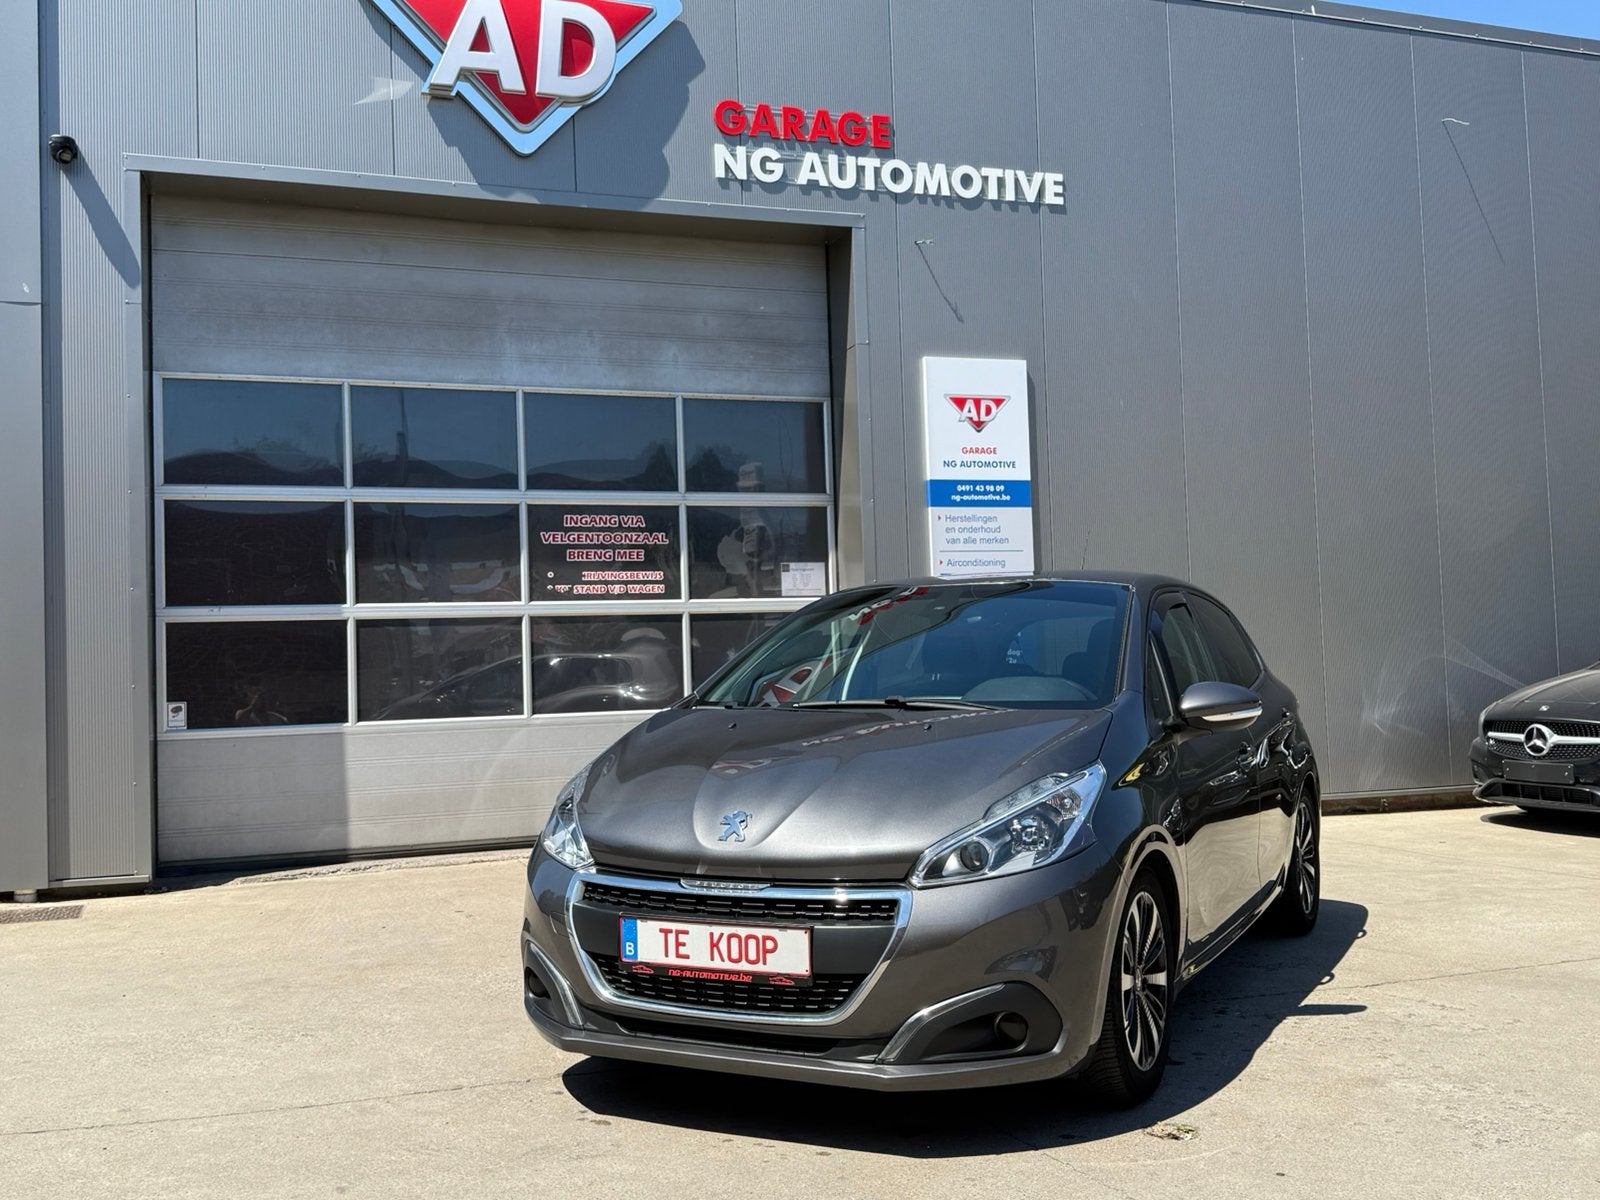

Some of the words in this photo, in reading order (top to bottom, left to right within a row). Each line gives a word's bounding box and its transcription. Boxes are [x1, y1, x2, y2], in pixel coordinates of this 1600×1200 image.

[426, 0, 617, 102] AD
[714, 100, 893, 149] GARAGE
[714, 143, 784, 183] NG
[797, 152, 1065, 205] AUTOMOTIVE
[959, 399, 998, 422] AD
[961, 446, 998, 455] GARAGE
[943, 460, 957, 468] NG
[960, 460, 1017, 469] AUTOMOTIVE
[956, 484, 973, 492] 0491
[975, 484, 984, 492] 43
[995, 484, 1005, 492] 09
[951, 493, 1011, 502] ng-automotive.be
[563, 514, 618, 528] INGANG
[620, 514, 646, 528] VIA
[944, 514, 998, 524] Herstellingen
[945, 526, 956, 534] en
[958, 525, 1001, 534] onderhoud
[540, 531, 669, 545] VELGENTOONZAAL
[963, 536, 977, 545] alle
[979, 537, 1009, 545] merken
[566, 549, 614, 562] BRENG
[615, 549, 645, 562] MEE
[947, 558, 1006, 569] Airconditioning
[573, 584, 607, 595] STAND
[627, 584, 665, 594] WAGEN
[625, 941, 635, 957] B
[658, 927, 690, 960] TE
[709, 931, 779, 966] KOOP
